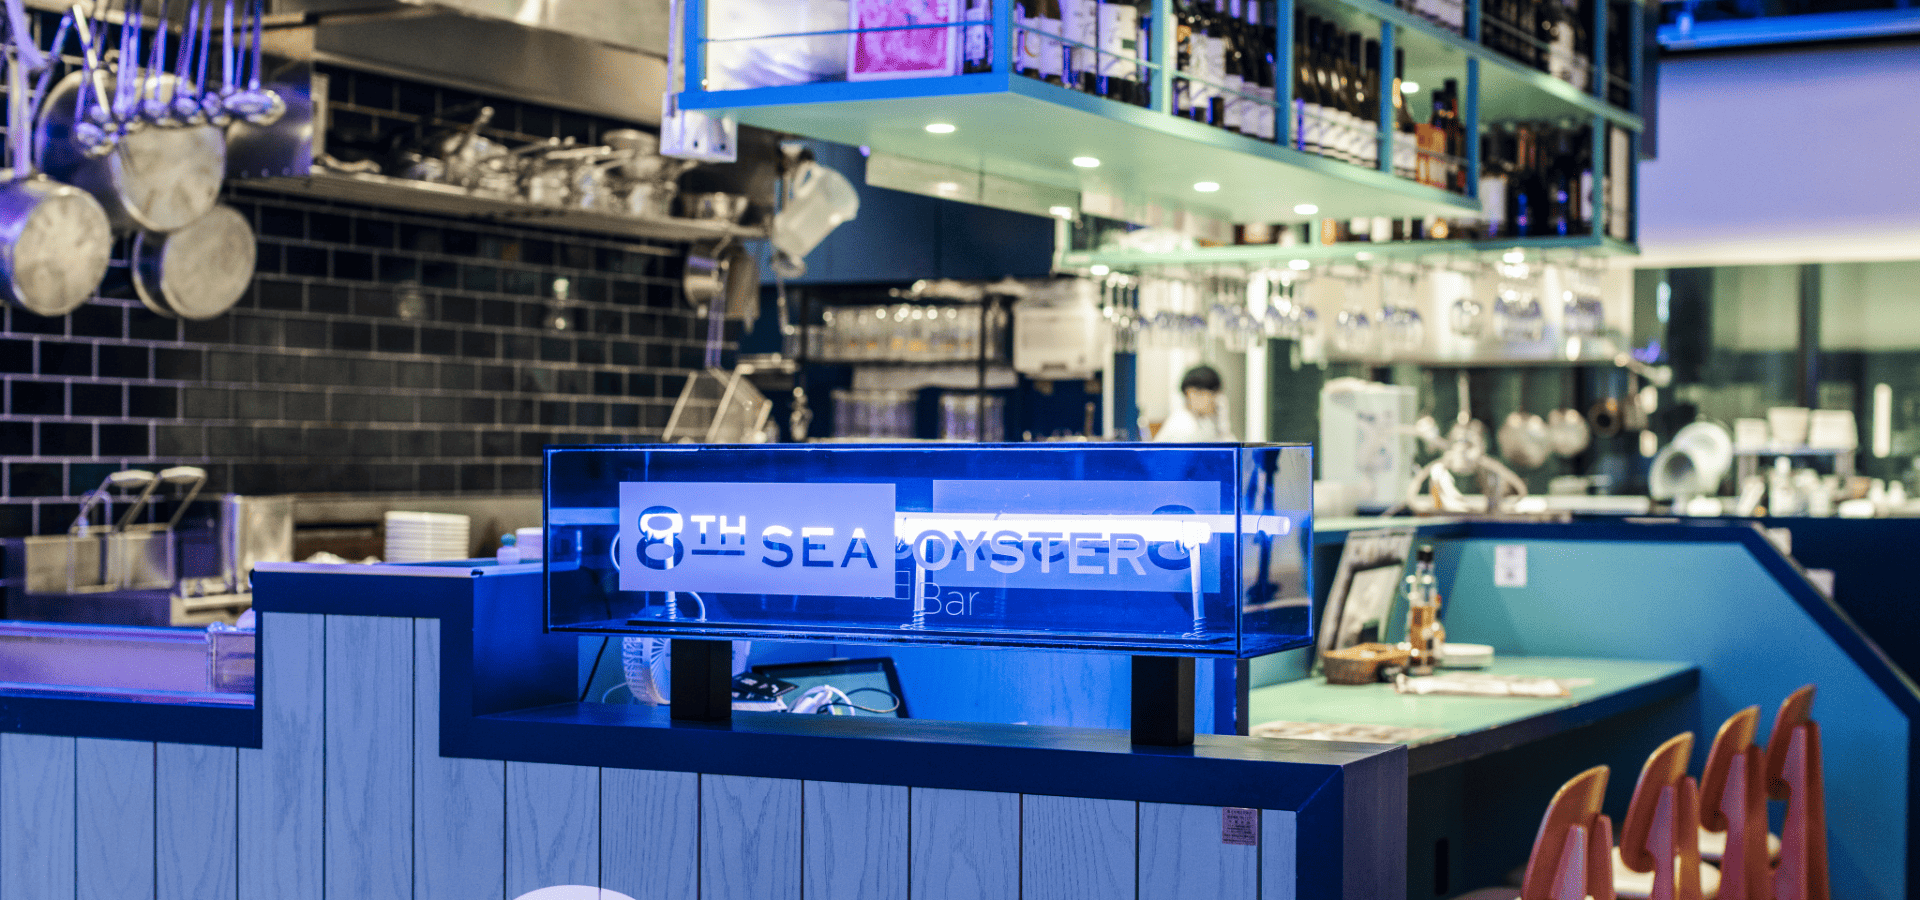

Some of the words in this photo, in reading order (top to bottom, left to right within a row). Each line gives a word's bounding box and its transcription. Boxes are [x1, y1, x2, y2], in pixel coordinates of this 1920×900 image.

[636, 505, 746, 571] 8TH
[762, 525, 878, 569] SEA
[912, 529, 1146, 576] OYSTER
[920, 582, 980, 616] Bar
